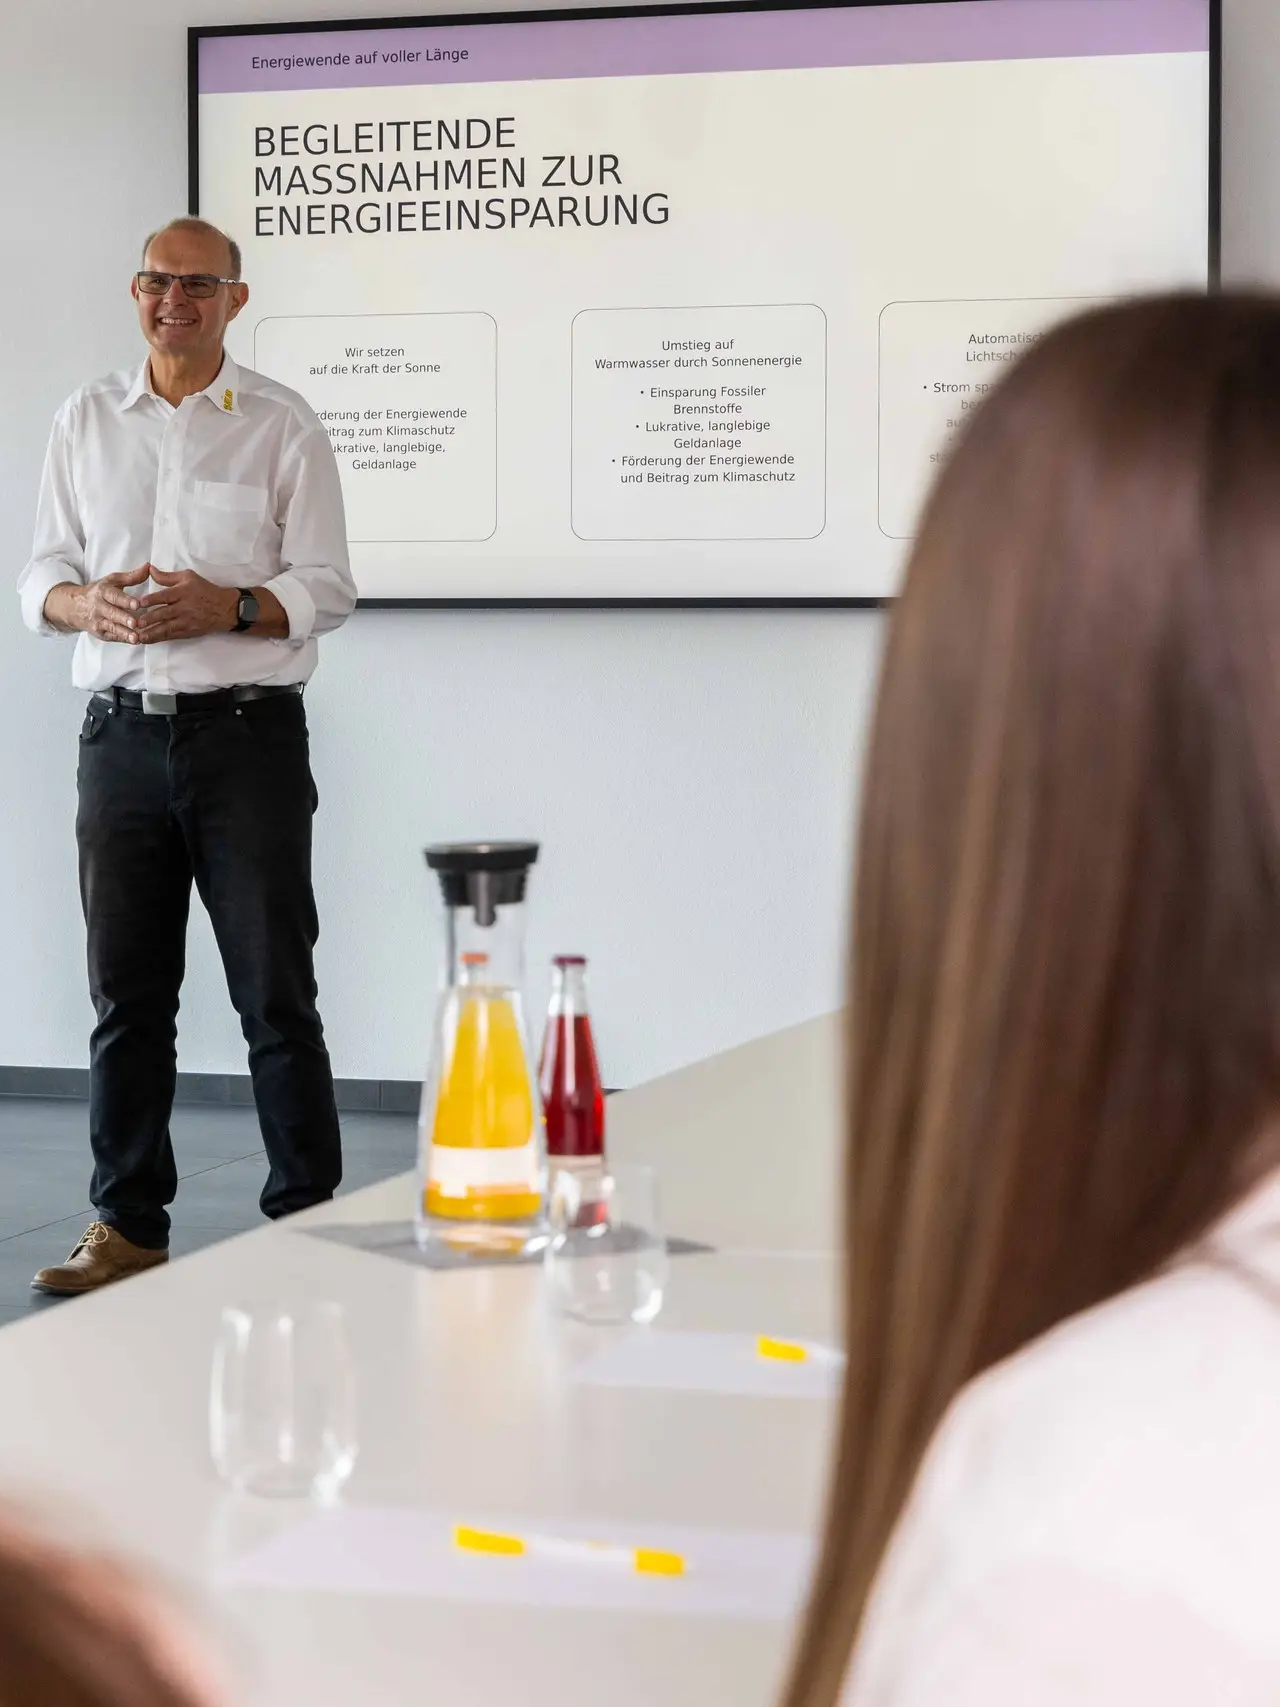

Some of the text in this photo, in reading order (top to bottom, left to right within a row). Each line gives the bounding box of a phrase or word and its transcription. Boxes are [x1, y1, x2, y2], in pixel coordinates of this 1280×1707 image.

[252, 48, 468, 71] Energiewende auf voller Länge
[255, 117, 515, 157] BEGLEITENDE
[256, 154, 622, 196] MASSNAHMEN ZUR
[256, 191, 668, 236] ENERGIEEINSPARUNG
[345, 348, 404, 357] Wir setzen
[662, 339, 734, 352] Umstieg auf
[310, 363, 440, 375] auf die Kraft der Sonne
[595, 355, 802, 369] Warmwasser durch Sonnenenergie
[651, 385, 766, 400] Einsparung Fossiler
[934, 383, 970, 392] Strom
[316, 408, 467, 422] rderung der Energiewende
[674, 403, 742, 415] Brennstoffe
[327, 424, 455, 439] itrag zum Klimaschutz
[646, 420, 770, 433] Lukrative, langlebige
[383, 442, 445, 454] langlebige,
[674, 437, 741, 450] Geldanlage
[352, 459, 416, 471] Geldanlage
[622, 454, 794, 468] Förderung der Energiewende
[621, 470, 795, 485] und Beitrag zum Klimaschutz
